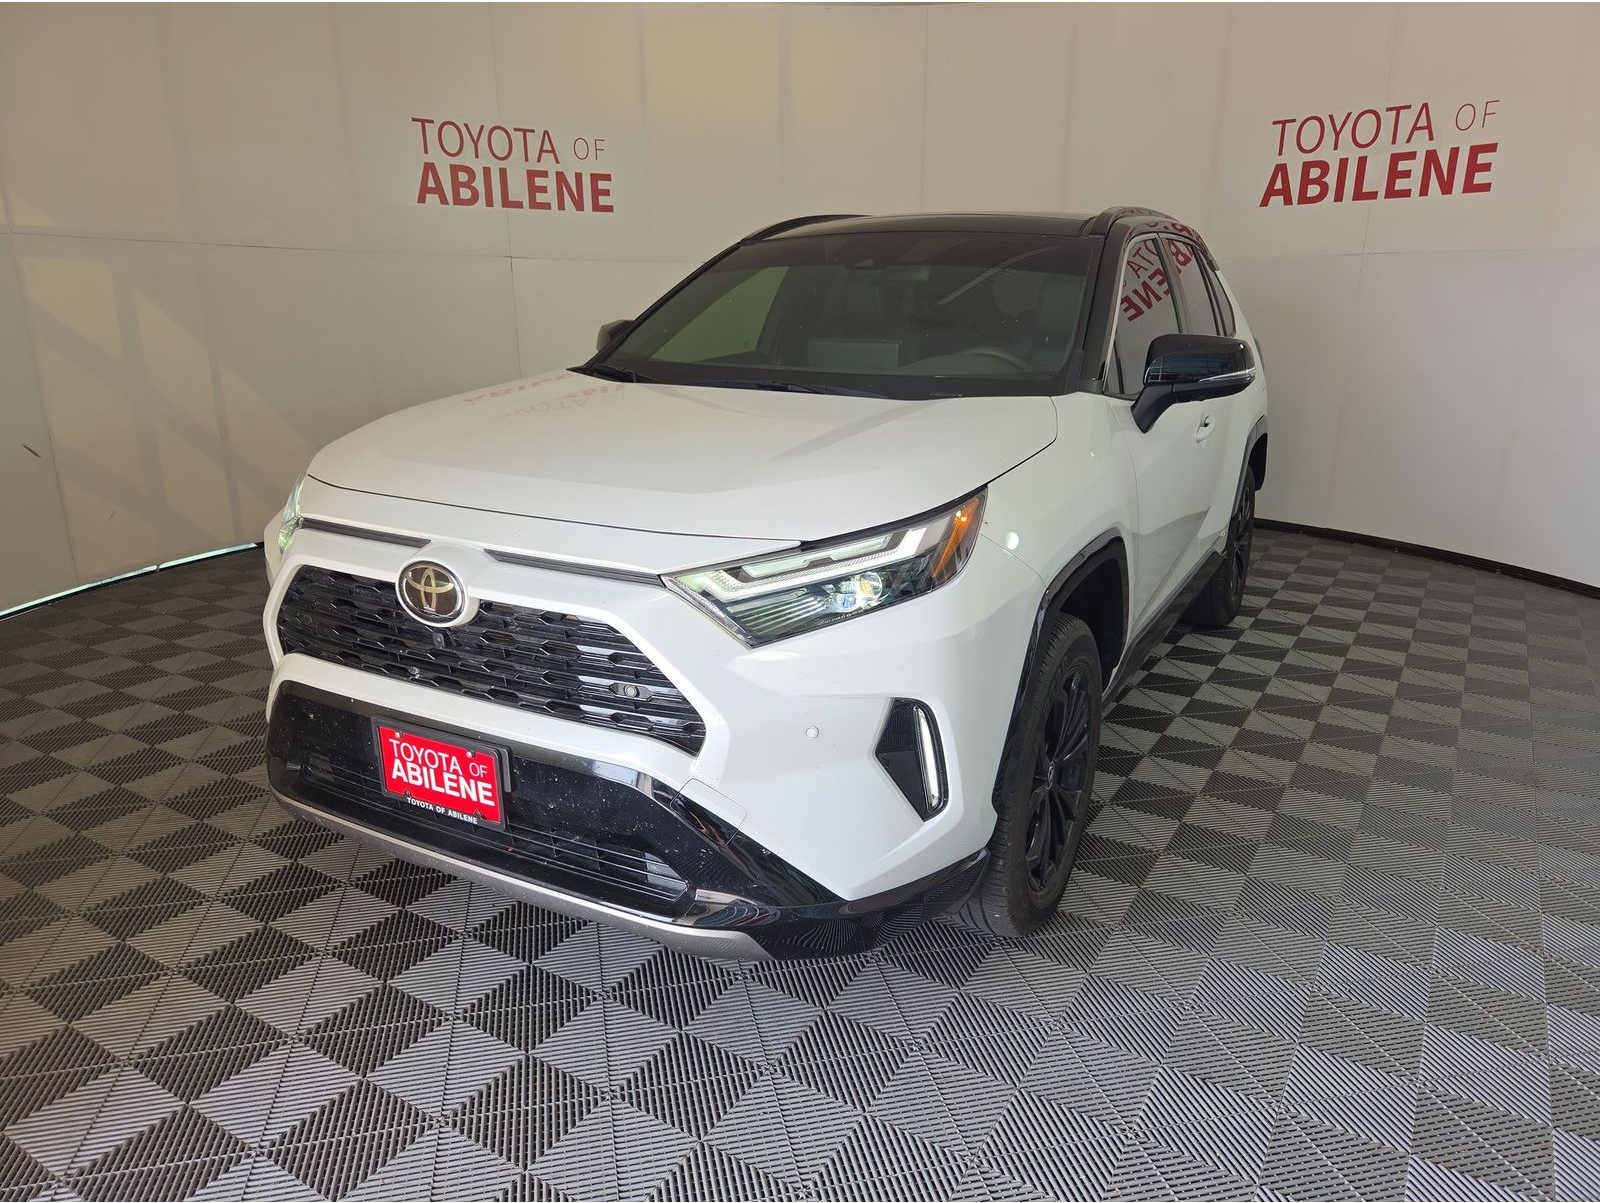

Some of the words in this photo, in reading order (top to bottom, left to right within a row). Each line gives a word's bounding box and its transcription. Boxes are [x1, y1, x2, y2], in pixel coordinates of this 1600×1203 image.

[411, 116, 560, 164] TOYOTA
[573, 137, 606, 160] OF
[1271, 102, 1435, 156] TOYOTA
[1455, 99, 1501, 132] OF
[416, 161, 615, 213] ABILENE
[1259, 142, 1499, 208] ABILENE
[388, 738, 463, 776] TOYOTA
[468, 762, 488, 779] OF
[391, 758, 496, 807] ABILENE
[406, 797, 434, 811] TOYOTA
[436, 806, 446, 815] OF
[447, 809, 479, 825] ABILENE
